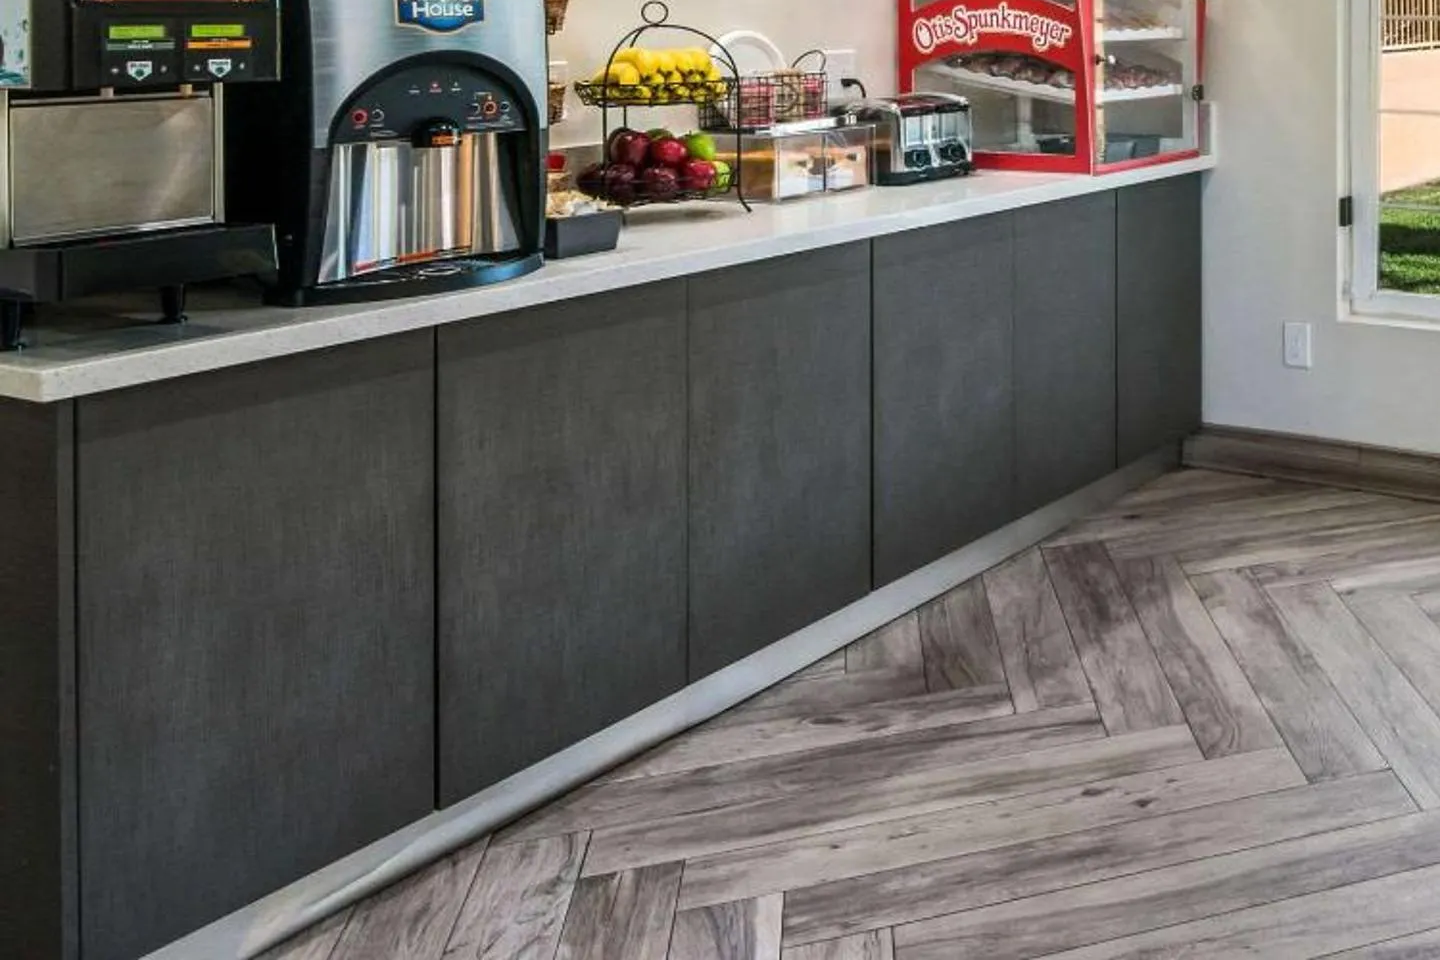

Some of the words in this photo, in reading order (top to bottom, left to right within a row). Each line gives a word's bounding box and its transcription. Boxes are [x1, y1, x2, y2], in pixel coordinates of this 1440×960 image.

[412, 1, 474, 18] House
[913, 19, 953, 53] Otis
[953, 1, 1072, 53] Spunkmeyer
